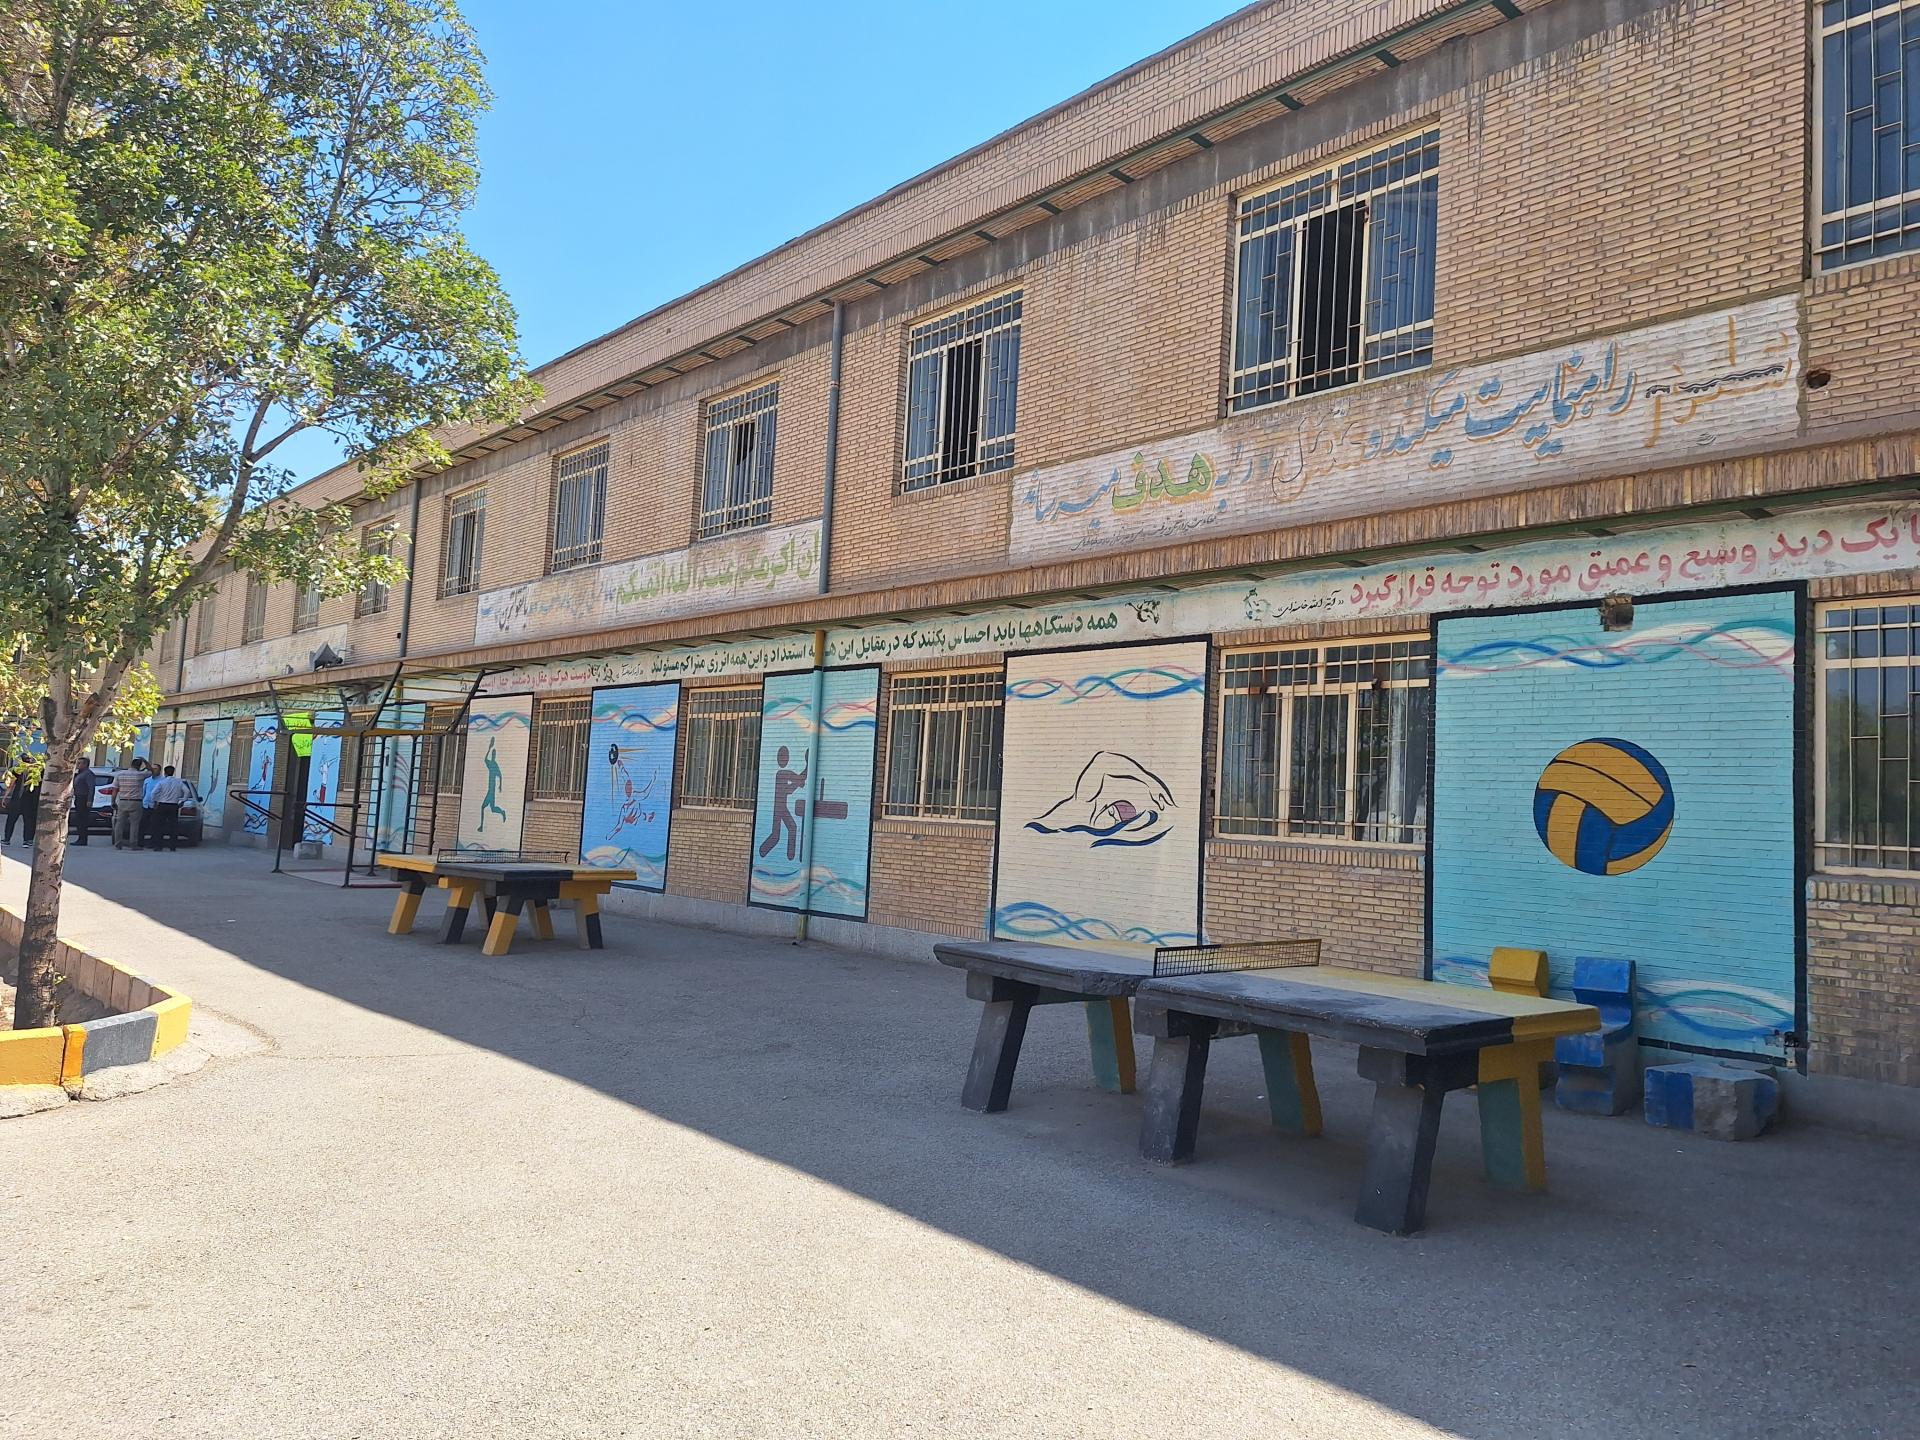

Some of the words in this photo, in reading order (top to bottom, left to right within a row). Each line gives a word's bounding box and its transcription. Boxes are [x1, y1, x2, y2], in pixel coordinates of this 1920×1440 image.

[1111, 451, 1217, 514] هدف
[1768, 529, 1833, 568] دید
[1841, 516, 1899, 560] یک
[1578, 550, 1650, 593] عمیق
[1657, 554, 1673, 583] و
[1679, 543, 1757, 582] وسیع
[1351, 573, 1398, 614] گیرد
[1394, 566, 1435, 610] قرار
[1507, 564, 1571, 597] مورد
[993, 620, 1016, 647] باید
[1019, 614, 1084, 644] دستگاهها
[1087, 612, 1118, 631] همه
[838, 639, 854, 661] این
[855, 635, 886, 660] مقابل
[886, 635, 900, 657] در
[903, 630, 918, 649] که
[918, 628, 946, 652] بکنند
[948, 624, 991, 651] احساس
[730, 653, 748, 666] همه
[747, 648, 763, 669] این
